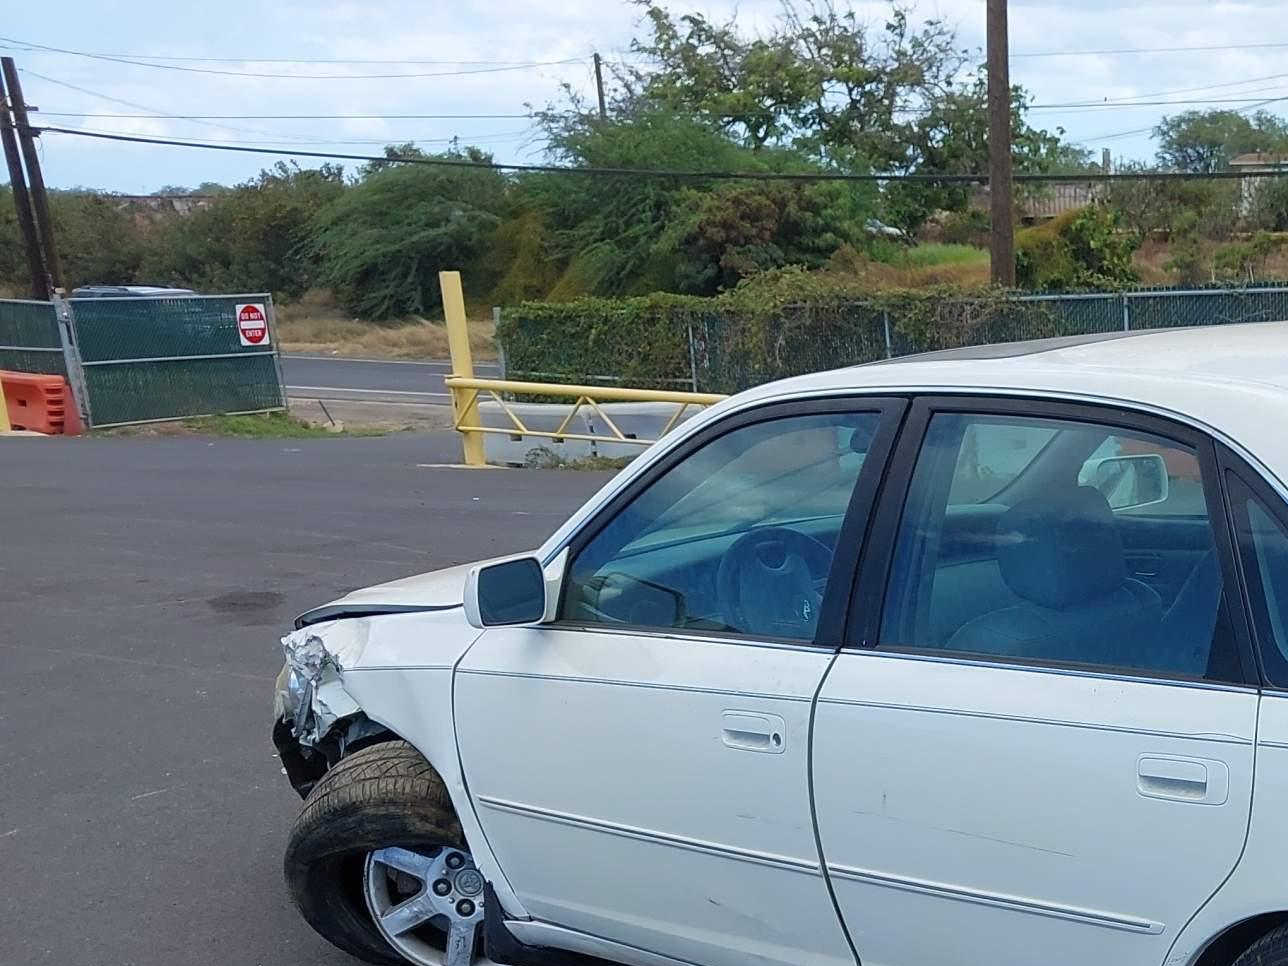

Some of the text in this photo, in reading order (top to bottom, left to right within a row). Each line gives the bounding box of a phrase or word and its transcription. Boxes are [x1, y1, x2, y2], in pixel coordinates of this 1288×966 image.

[241, 312, 261, 320] DO NOT
[245, 330, 262, 338] ENTER
